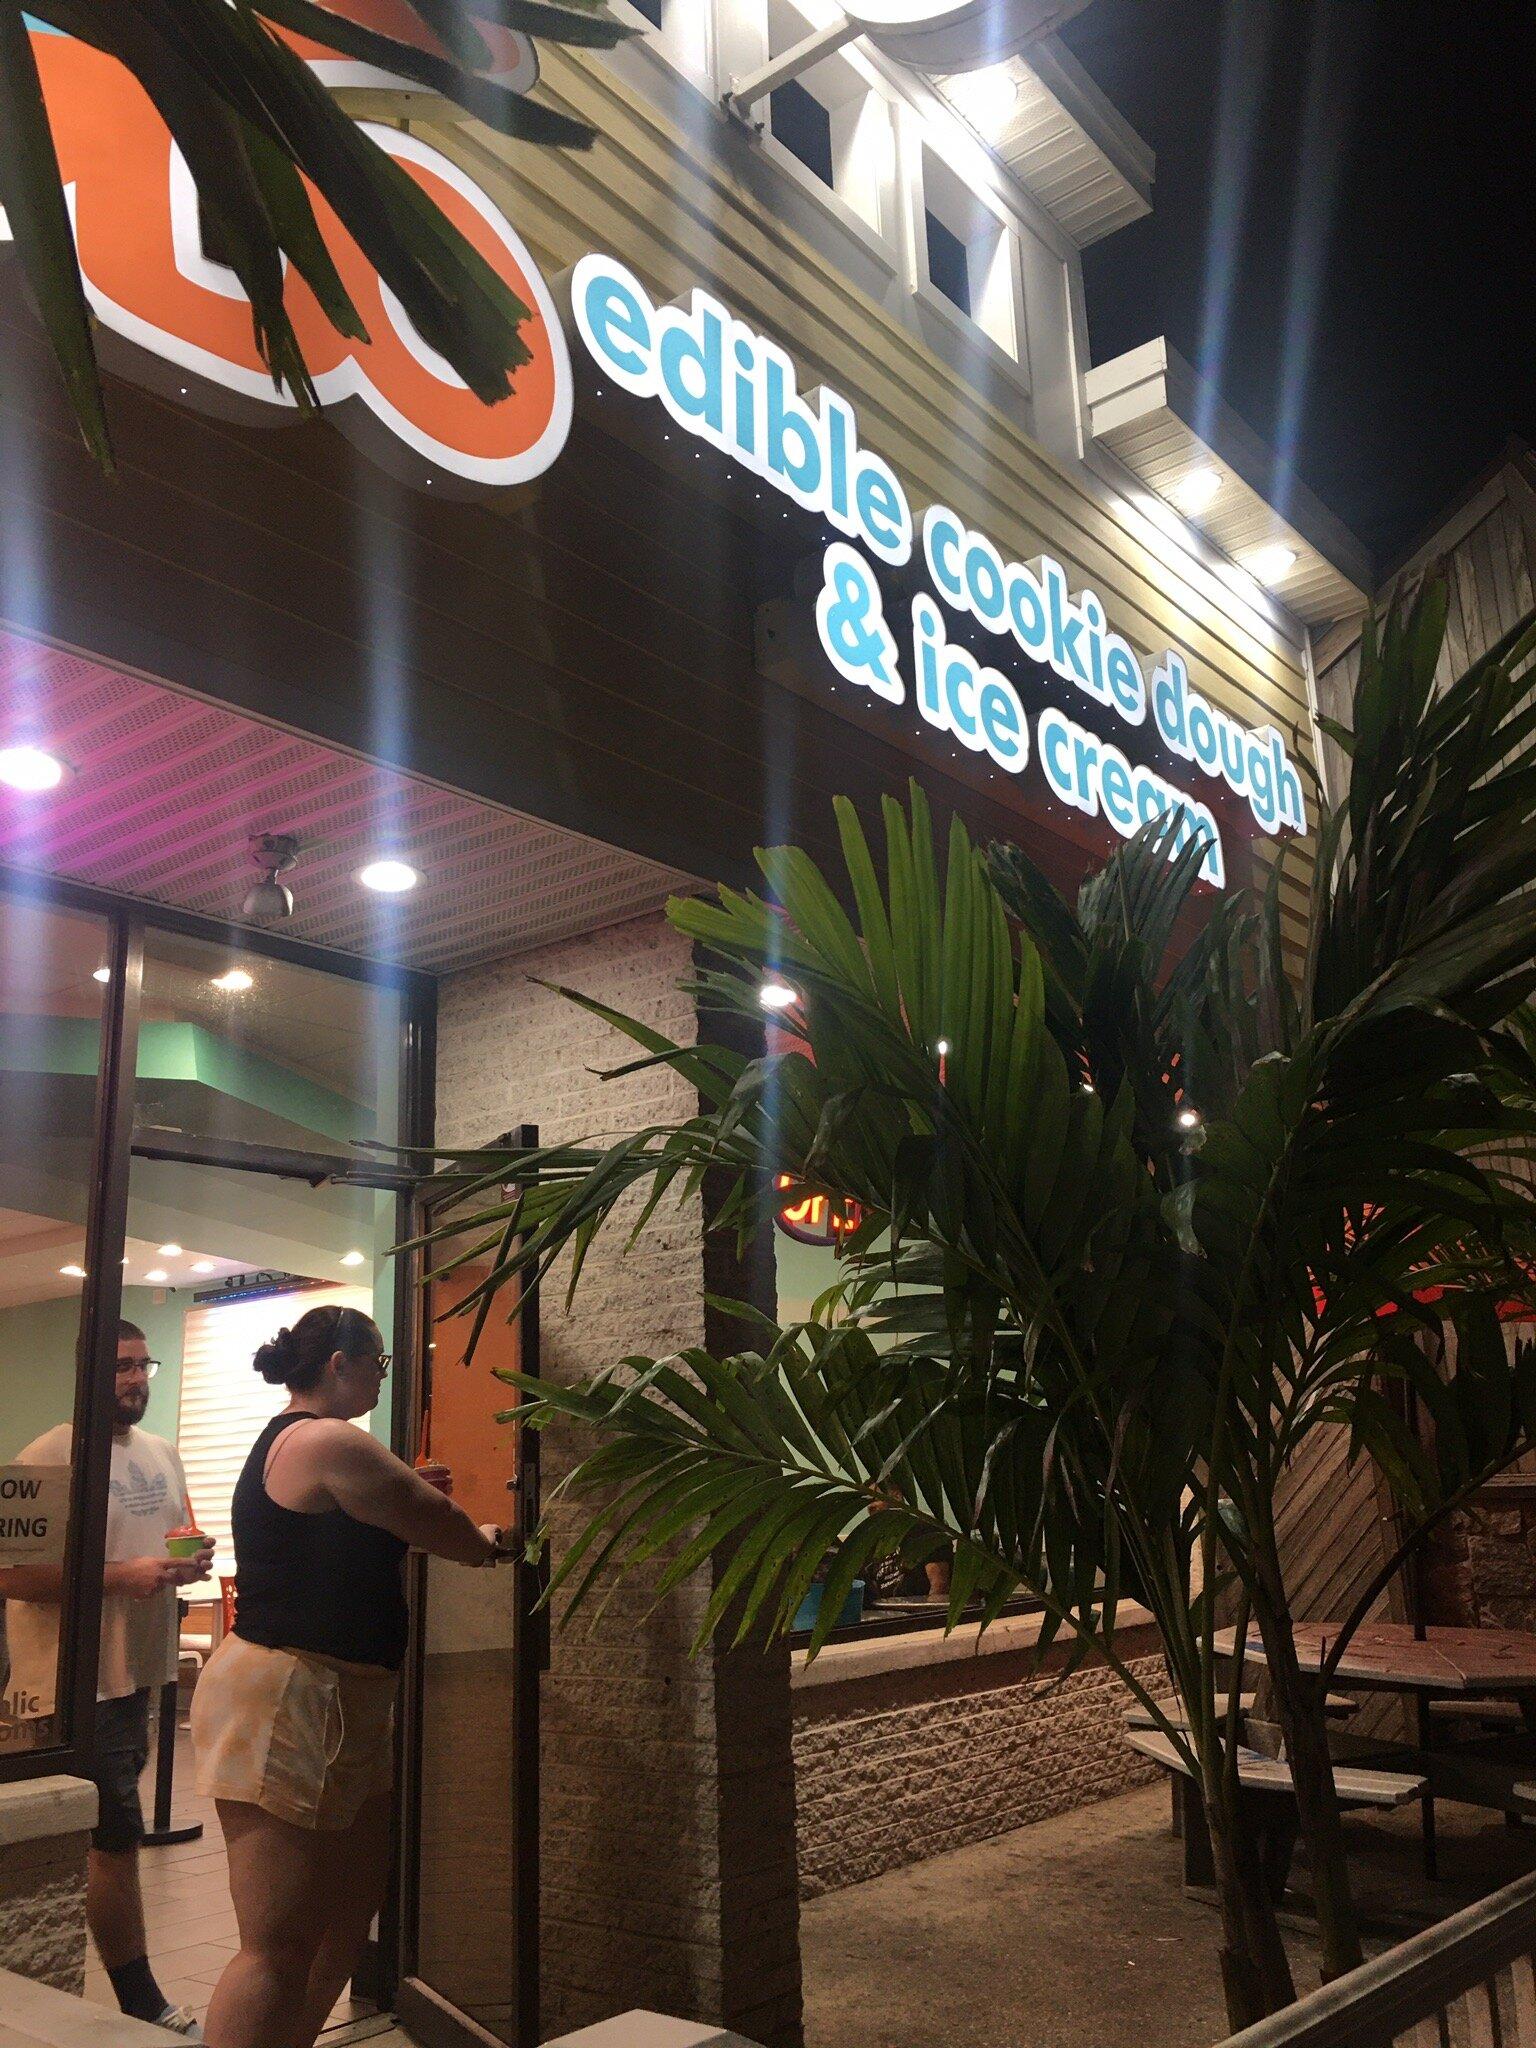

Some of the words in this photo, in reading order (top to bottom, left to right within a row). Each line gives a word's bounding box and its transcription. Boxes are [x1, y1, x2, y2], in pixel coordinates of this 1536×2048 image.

[584, 274, 904, 551] edible
[929, 519, 1141, 713] cookie
[1155, 664, 1303, 825] dough
[826, 561, 893, 685] &
[919, 609, 1020, 758] ice
[1044, 722, 1219, 876] cream
